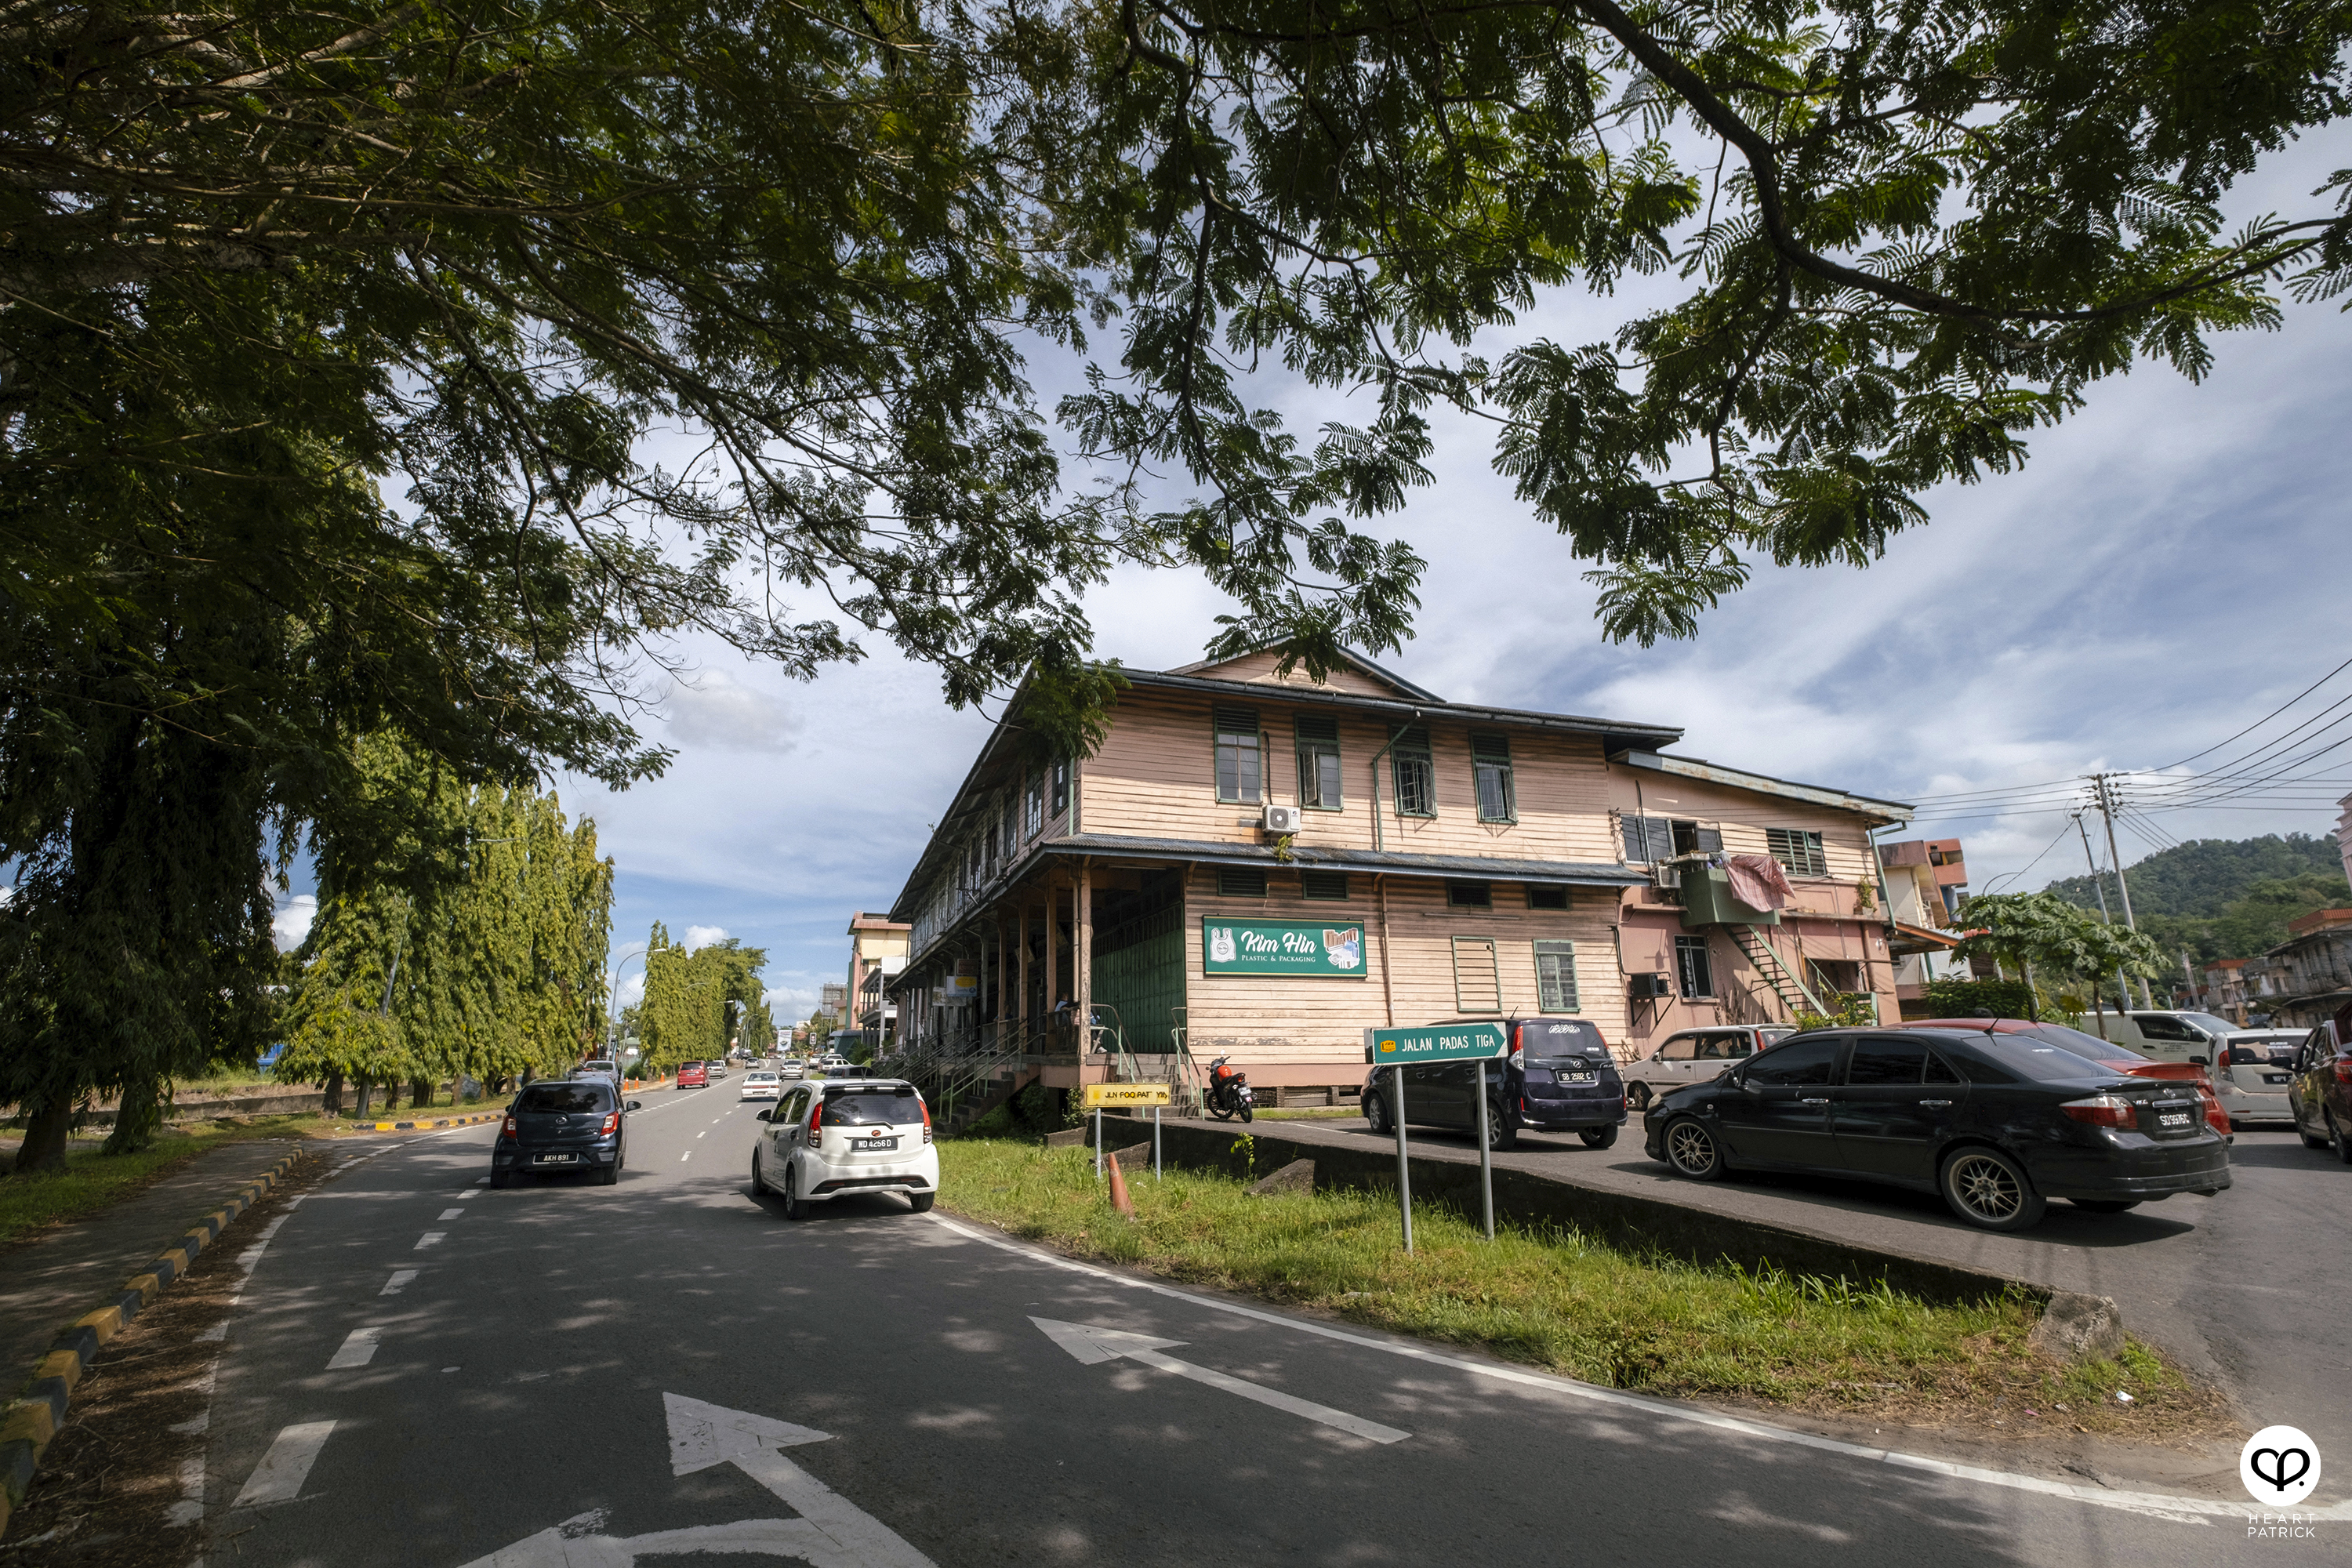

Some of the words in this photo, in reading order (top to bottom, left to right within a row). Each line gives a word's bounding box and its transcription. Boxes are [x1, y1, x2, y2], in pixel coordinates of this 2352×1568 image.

[1240, 931, 1279, 953] Kim
[1282, 931, 1317, 954] Hin
[1402, 1037, 1432, 1052] JALAN
[1439, 1035, 1468, 1050] PADAS
[1475, 1034, 1496, 1048] TIGA
[858, 1140, 868, 1149] WD
